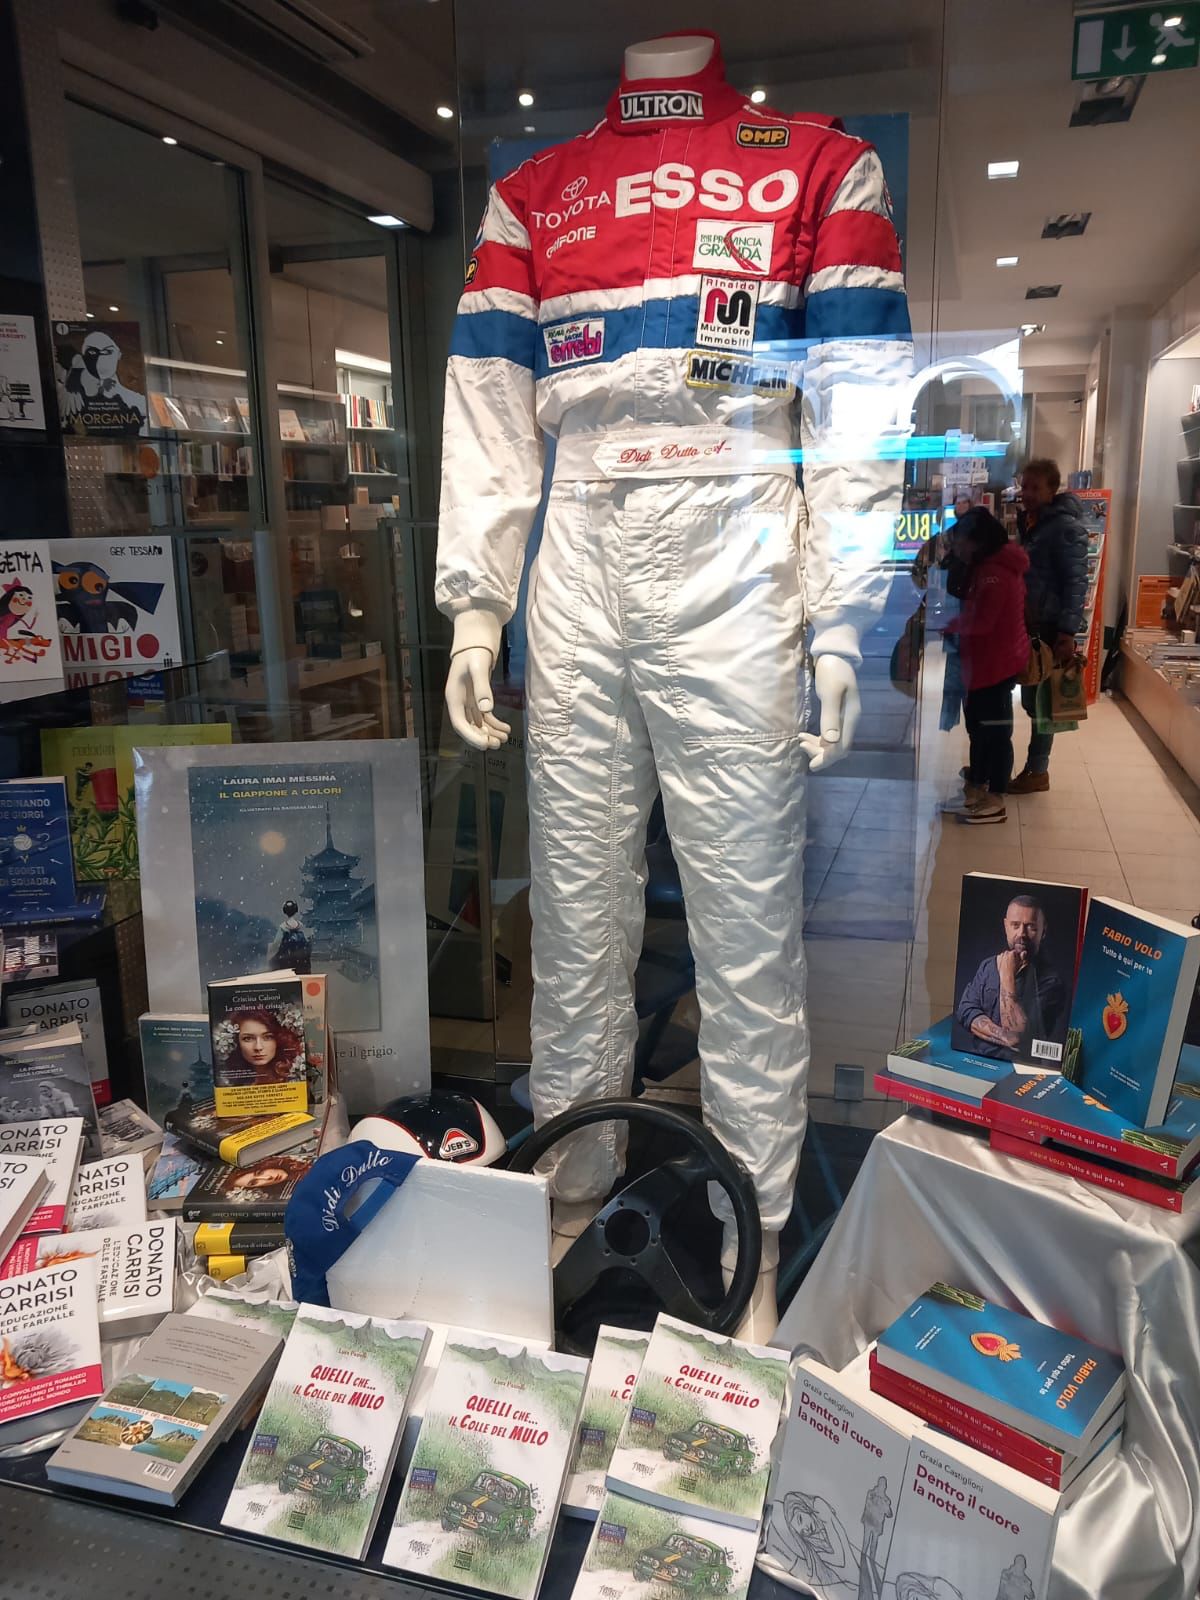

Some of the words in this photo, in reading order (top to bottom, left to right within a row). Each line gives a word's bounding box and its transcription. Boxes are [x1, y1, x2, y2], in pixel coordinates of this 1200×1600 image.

[620, 92, 703, 119] ULTRON
[740, 130, 784, 144] OMP
[614, 163, 799, 218] ESSO
[531, 190, 611, 229] TOYOTA
[713, 234, 762, 247] PRVINCIA
[705, 278, 755, 291] Rinaldo
[700, 323, 750, 336] Muratore
[690, 358, 787, 389] MICHELIN
[70, 412, 140, 425] MORGANA
[110, 546, 126, 556] GEK
[288, 775, 337, 783] MESSINA
[232, 789, 289, 798] GIAPPONE
[302, 787, 342, 795] COLORI
[11, 877, 56, 886] SQUADRA
[1102, 926, 1132, 947] FABIO
[1134, 940, 1162, 960] VOLO
[1133, 962, 1145, 971] per
[20, 997, 90, 1019] DONATO
[232, 995, 257, 1003] Cristina
[27, 1012, 89, 1030] ARRISI
[350, 1046, 357, 1057] il
[360, 1045, 396, 1060] grigio.
[0, 1137, 61, 1153] ARRISI
[444, 1139, 473, 1153] JEB'S
[1096, 1141, 1109, 1150] per
[78, 1161, 129, 1183] NATO
[73, 1175, 126, 1196] RRISI
[321, 1186, 342, 1233] Didi
[340, 1150, 393, 1188] Dutto
[81, 1196, 127, 1212] FARFALLE
[123, 1232, 143, 1298] CARRISI
[145, 1226, 165, 1298] DONATO
[0, 1285, 73, 1316] ARRISI
[23, 1310, 75, 1329] FARFALLE
[310, 1364, 354, 1386] QUELLI
[679, 1364, 723, 1386] QUELLI
[1072, 1357, 1097, 1385] FABIO
[293, 1384, 302, 1396] IL
[331, 1392, 346, 1404] DEL
[347, 1392, 385, 1411] MULO
[610, 1389, 618, 1399] IL
[663, 1375, 673, 1385] IL
[703, 1387, 720, 1401] DEL
[721, 1390, 760, 1410] MULO
[802, 1379, 823, 1397] Grazia
[823, 1393, 855, 1419] Castiglioni
[1055, 1383, 1080, 1409] VOLO
[466, 1395, 512, 1418] QUELLI
[448, 1415, 458, 1427] IL
[490, 1425, 507, 1439] DEL
[508, 1424, 549, 1447] MULO
[797, 1406, 808, 1422] la
[809, 1414, 840, 1445] notte
[800, 1391, 840, 1427] Dentro
[841, 1417, 849, 1432] il
[849, 1427, 884, 1459] cuore
[919, 1450, 943, 1469] Grazia
[944, 1463, 984, 1494] Castiglioni
[912, 1479, 925, 1496] la
[926, 1487, 966, 1521] notte
[916, 1463, 966, 1503] Dentro
[967, 1495, 977, 1510] il
[979, 1505, 1021, 1535] cuore
